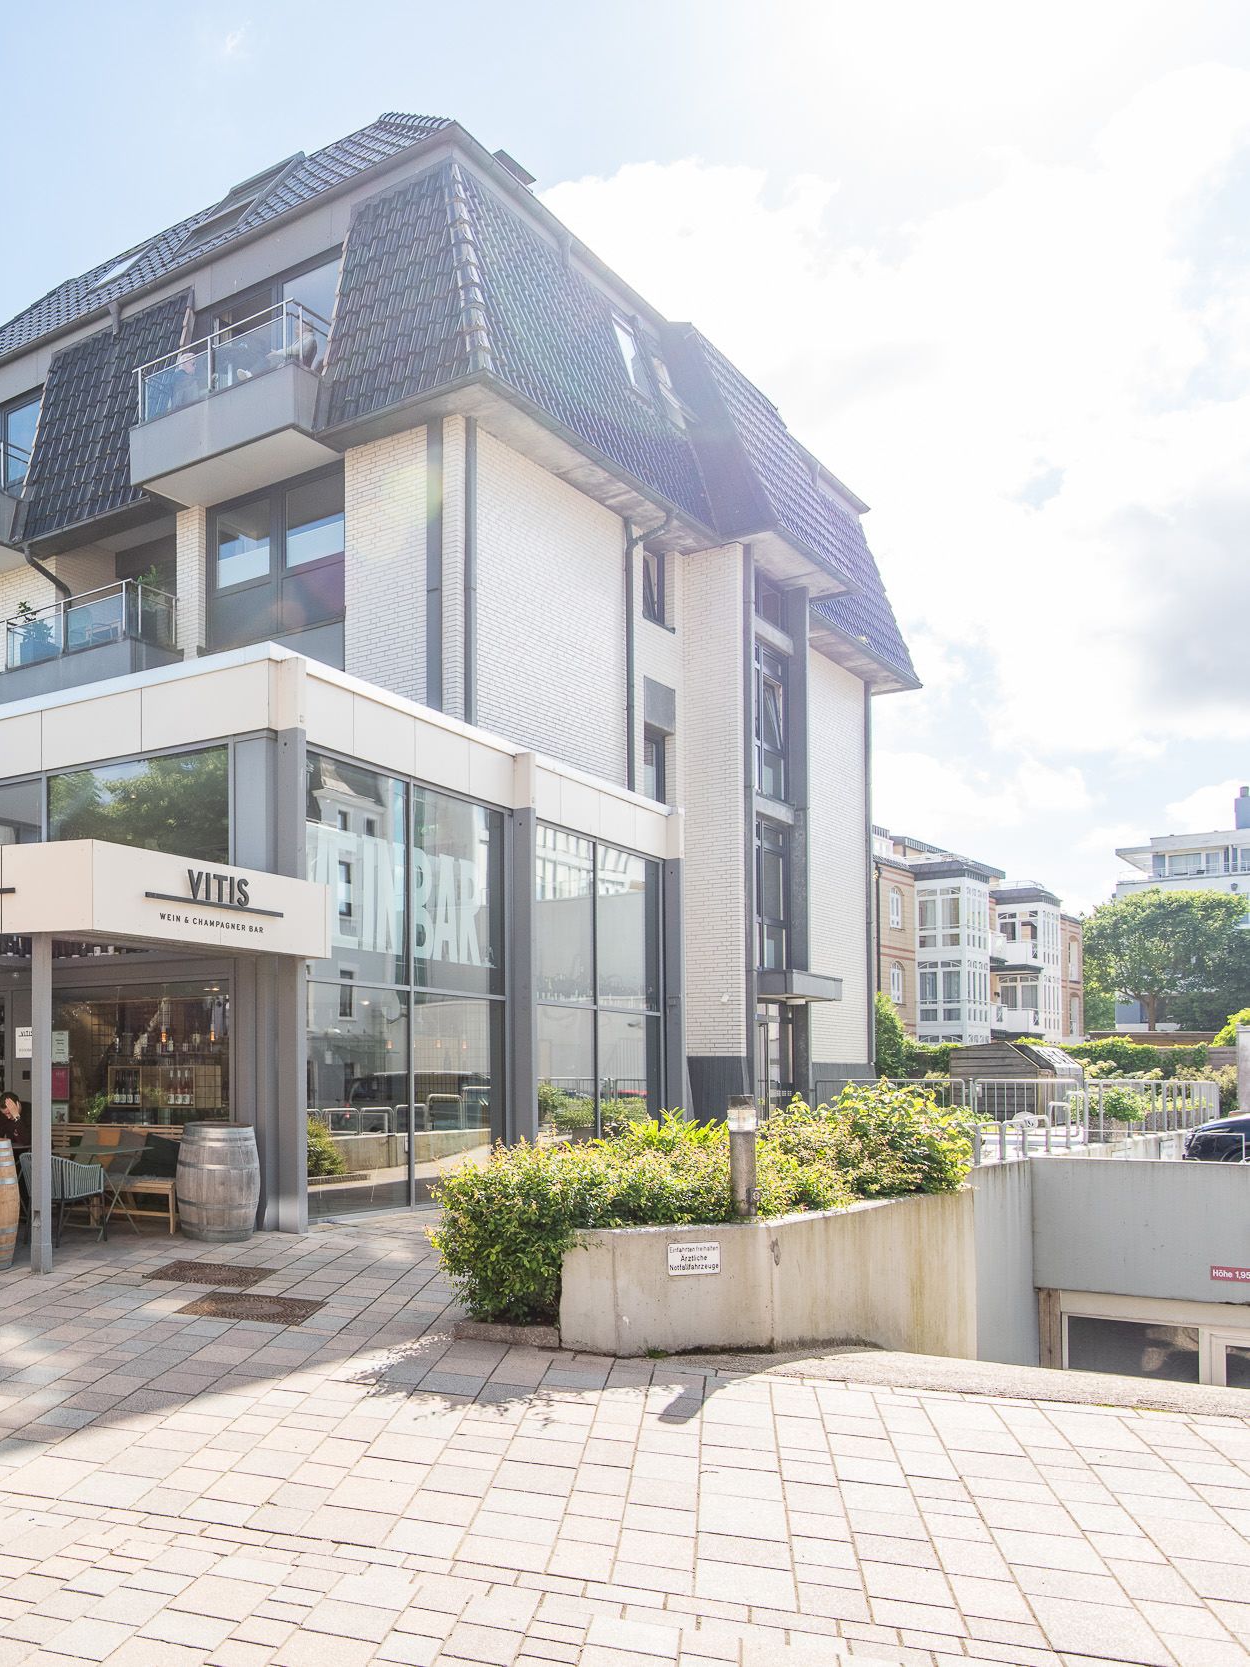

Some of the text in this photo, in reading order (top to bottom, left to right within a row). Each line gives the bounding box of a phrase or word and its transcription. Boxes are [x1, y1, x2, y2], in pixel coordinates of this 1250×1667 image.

[187, 869, 250, 907] VITIS
[159, 912, 181, 922] WEIN
[192, 917, 246, 931] CHAMPAGNER
[249, 925, 264, 933] BAR
[680, 1254, 708, 1262] Ärztliche
[669, 1263, 719, 1271] Notfallfahrzeuge
[1212, 1269, 1233, 1278] Höhe
